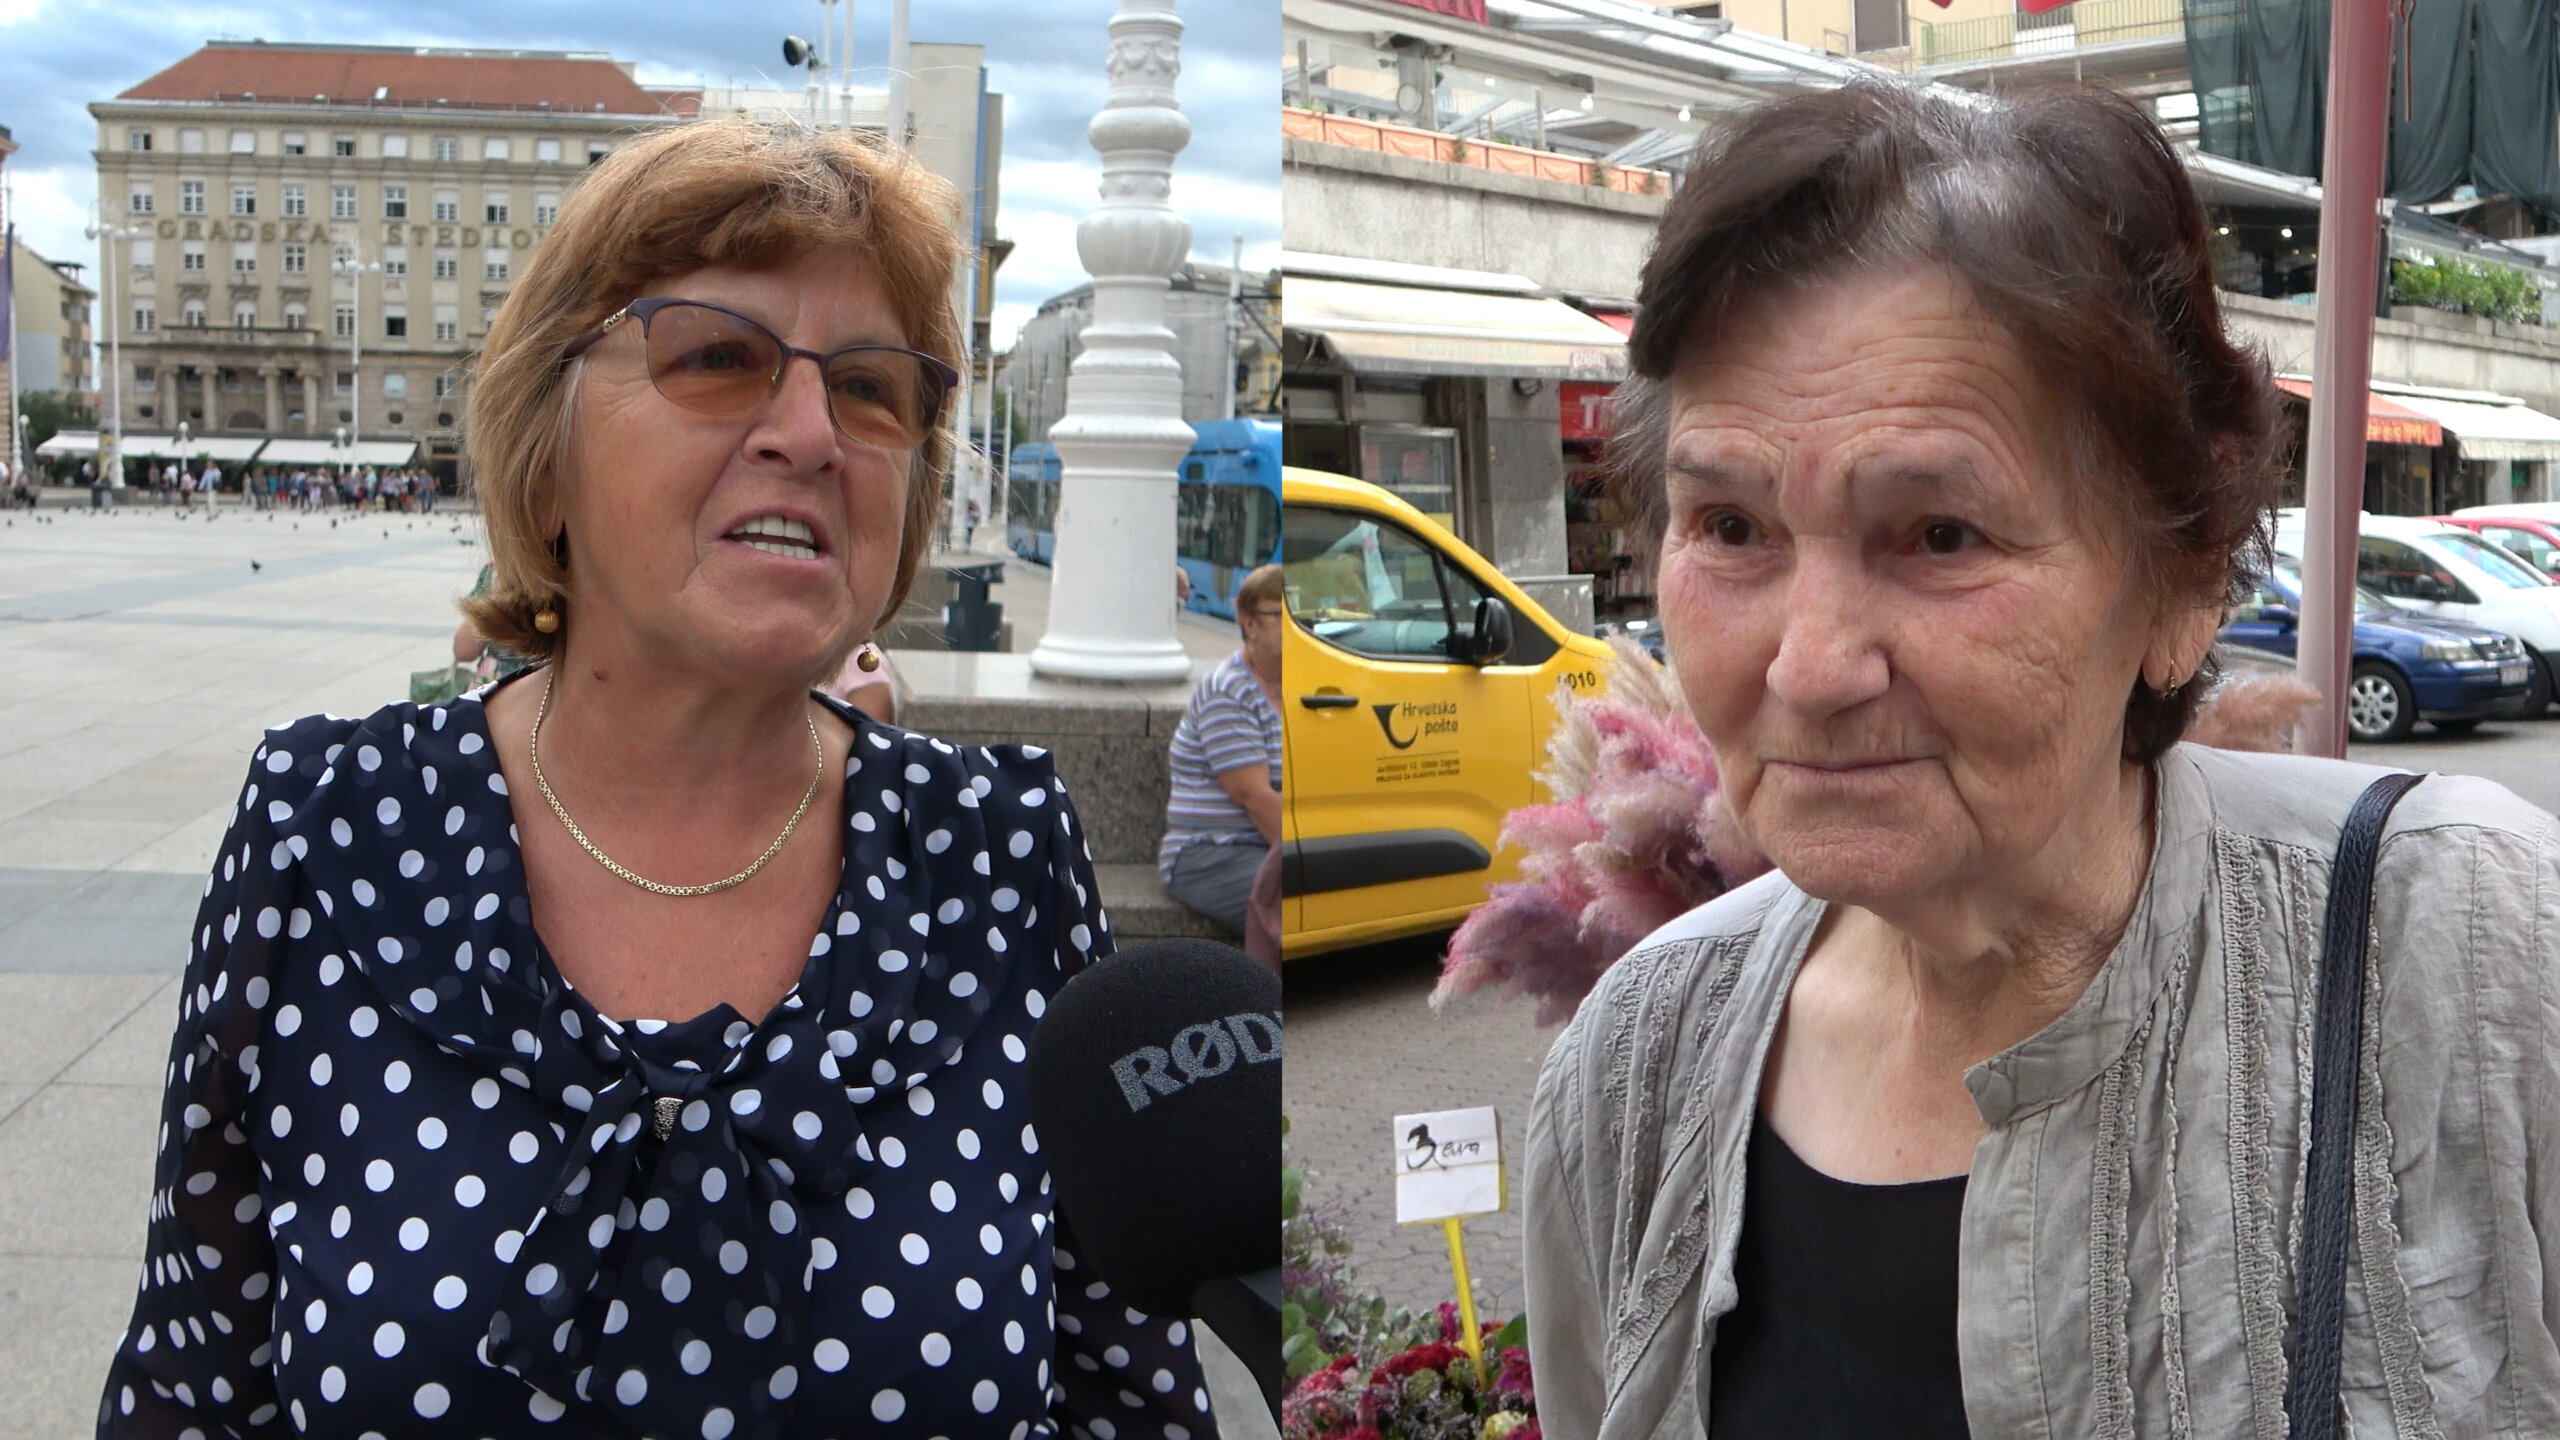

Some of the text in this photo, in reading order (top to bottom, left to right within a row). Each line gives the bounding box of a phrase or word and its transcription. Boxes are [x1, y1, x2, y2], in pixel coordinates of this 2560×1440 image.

[157, 219, 331, 245] GRADSKA
[1402, 700, 1457, 717] Hrvatska
[1424, 718, 1459, 736] pošta
[1109, 1011, 1282, 1112] RØD
[1407, 1123, 1438, 1170] 3
